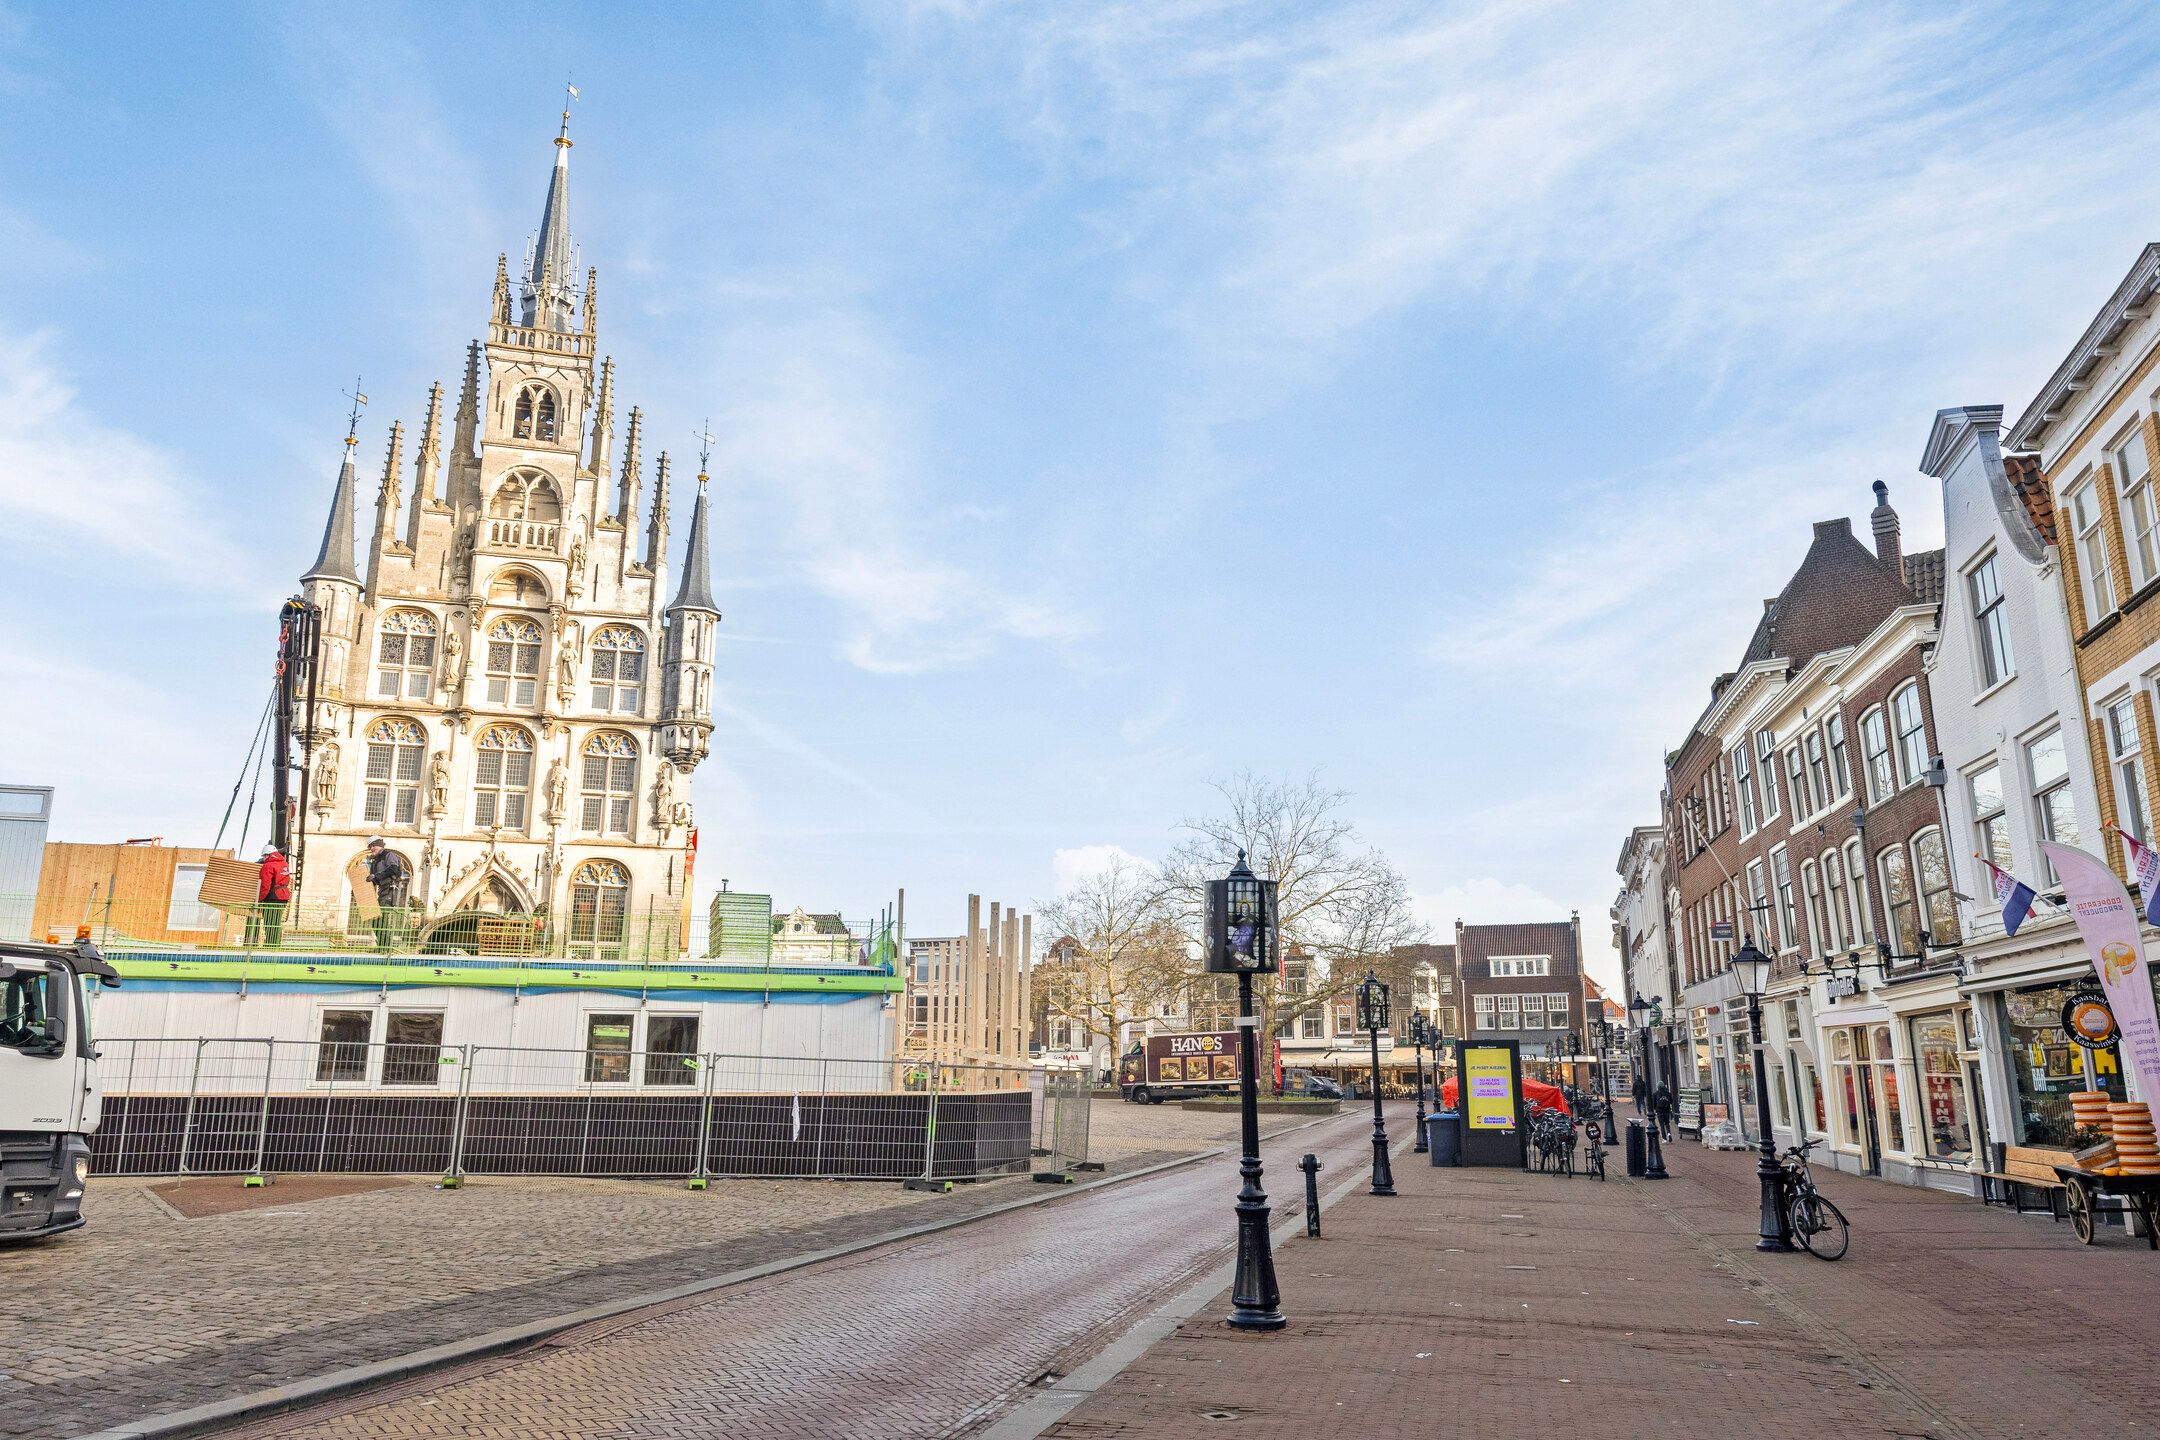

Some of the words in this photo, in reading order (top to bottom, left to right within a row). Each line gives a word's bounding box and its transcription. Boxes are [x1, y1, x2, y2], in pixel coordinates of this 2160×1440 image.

[2071, 994, 2109, 1005] Kaasbar
[1171, 1036, 1223, 1052] HANOS
[2073, 1034, 2119, 1049] Kaaswinkel
